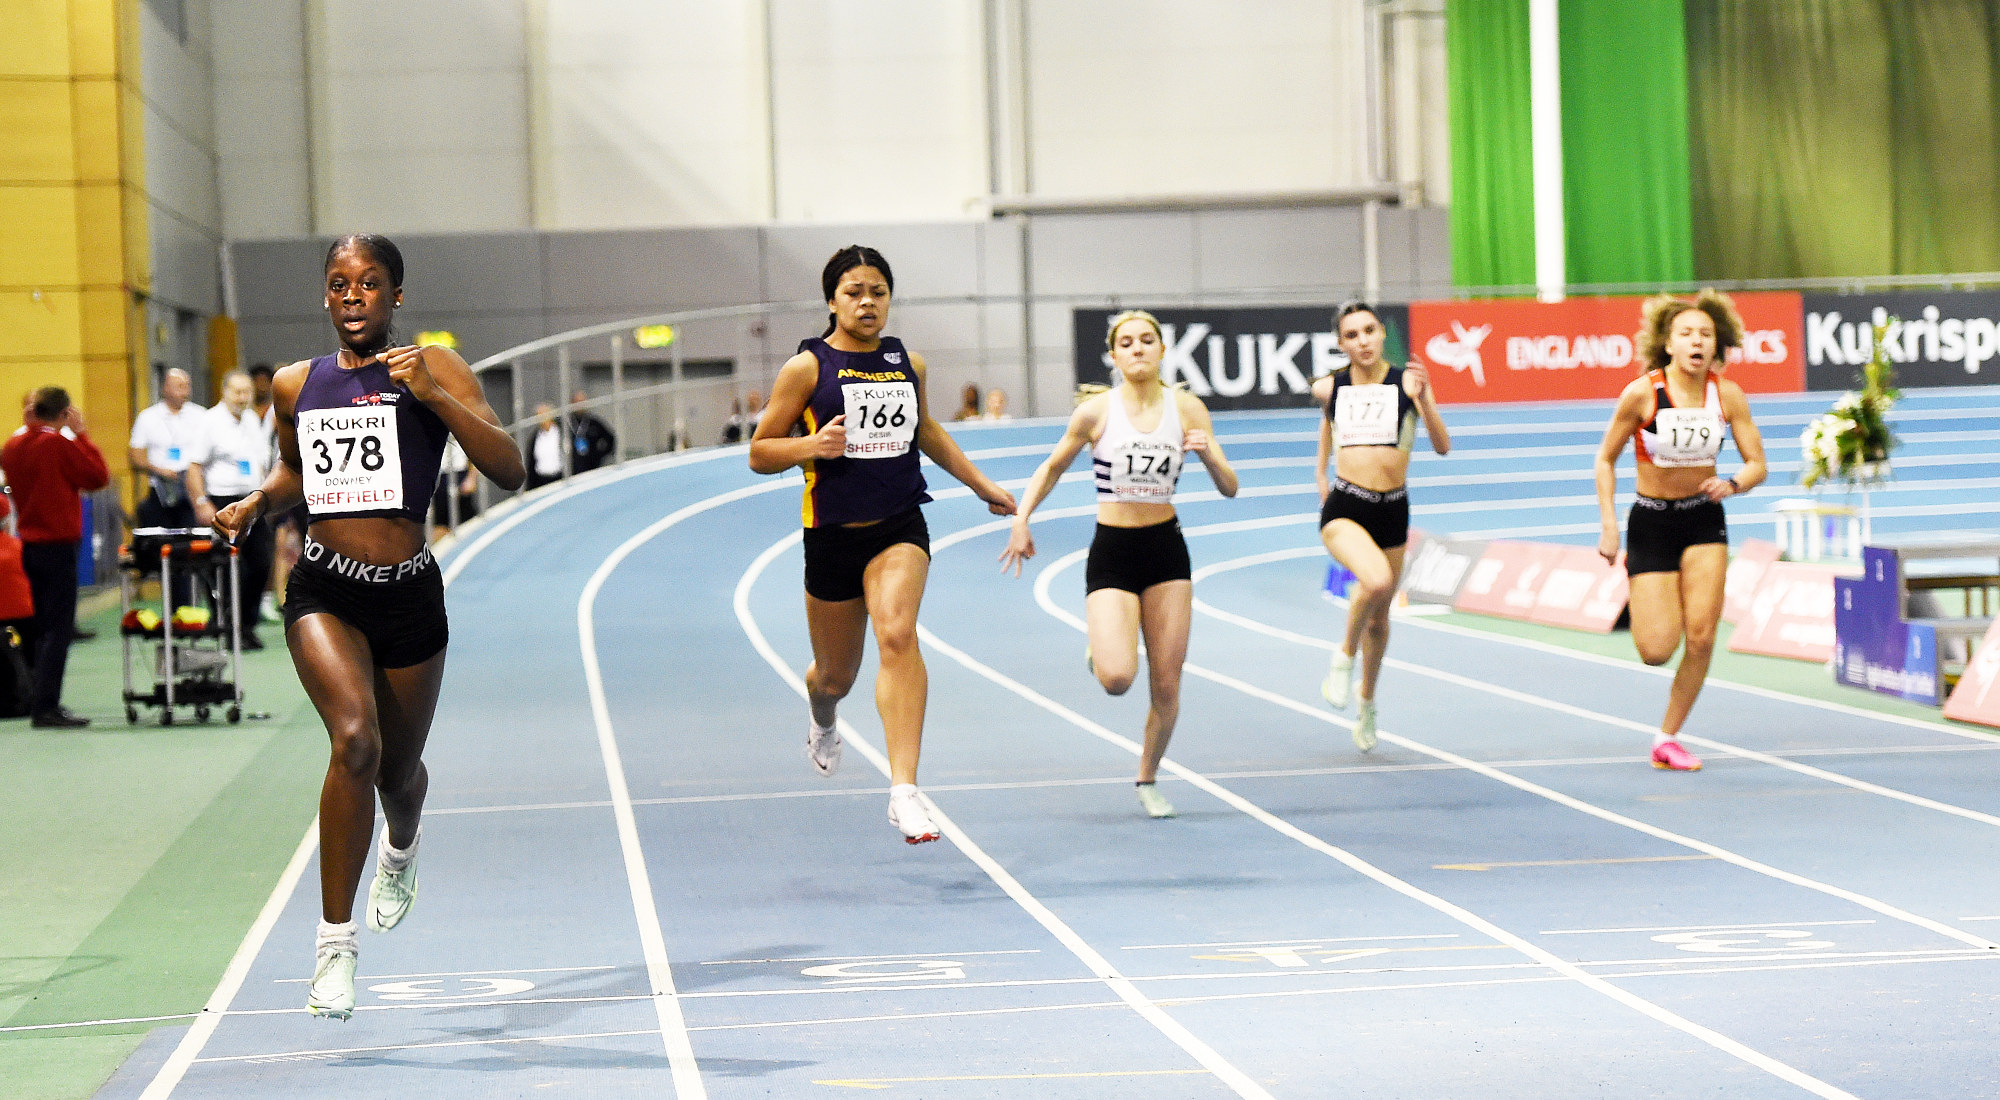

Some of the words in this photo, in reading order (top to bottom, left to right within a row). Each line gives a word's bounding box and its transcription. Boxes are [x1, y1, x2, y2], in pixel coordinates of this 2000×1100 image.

[1807, 305, 2000, 374] Kukrisp
[1506, 334, 1632, 370] ENGLAND
[838, 369, 906, 381] ARCHERS
[864, 389, 909, 400] KUKRI
[859, 403, 906, 429] 166
[1349, 402, 1385, 421] 177
[321, 417, 385, 431] KUKRI
[1672, 427, 1710, 448] 179
[312, 436, 384, 474] 378
[1126, 454, 1170, 475] 174
[325, 476, 372, 487] DOWNEY
[307, 489, 395, 506] SHEFFIELD
[327, 552, 392, 582] NIKE
[396, 542, 430, 581] PRO
[1650, 929, 1836, 953] 3
[1217, 945, 1392, 968] 4
[801, 960, 966, 985] 5
[368, 978, 535, 1001] 6
